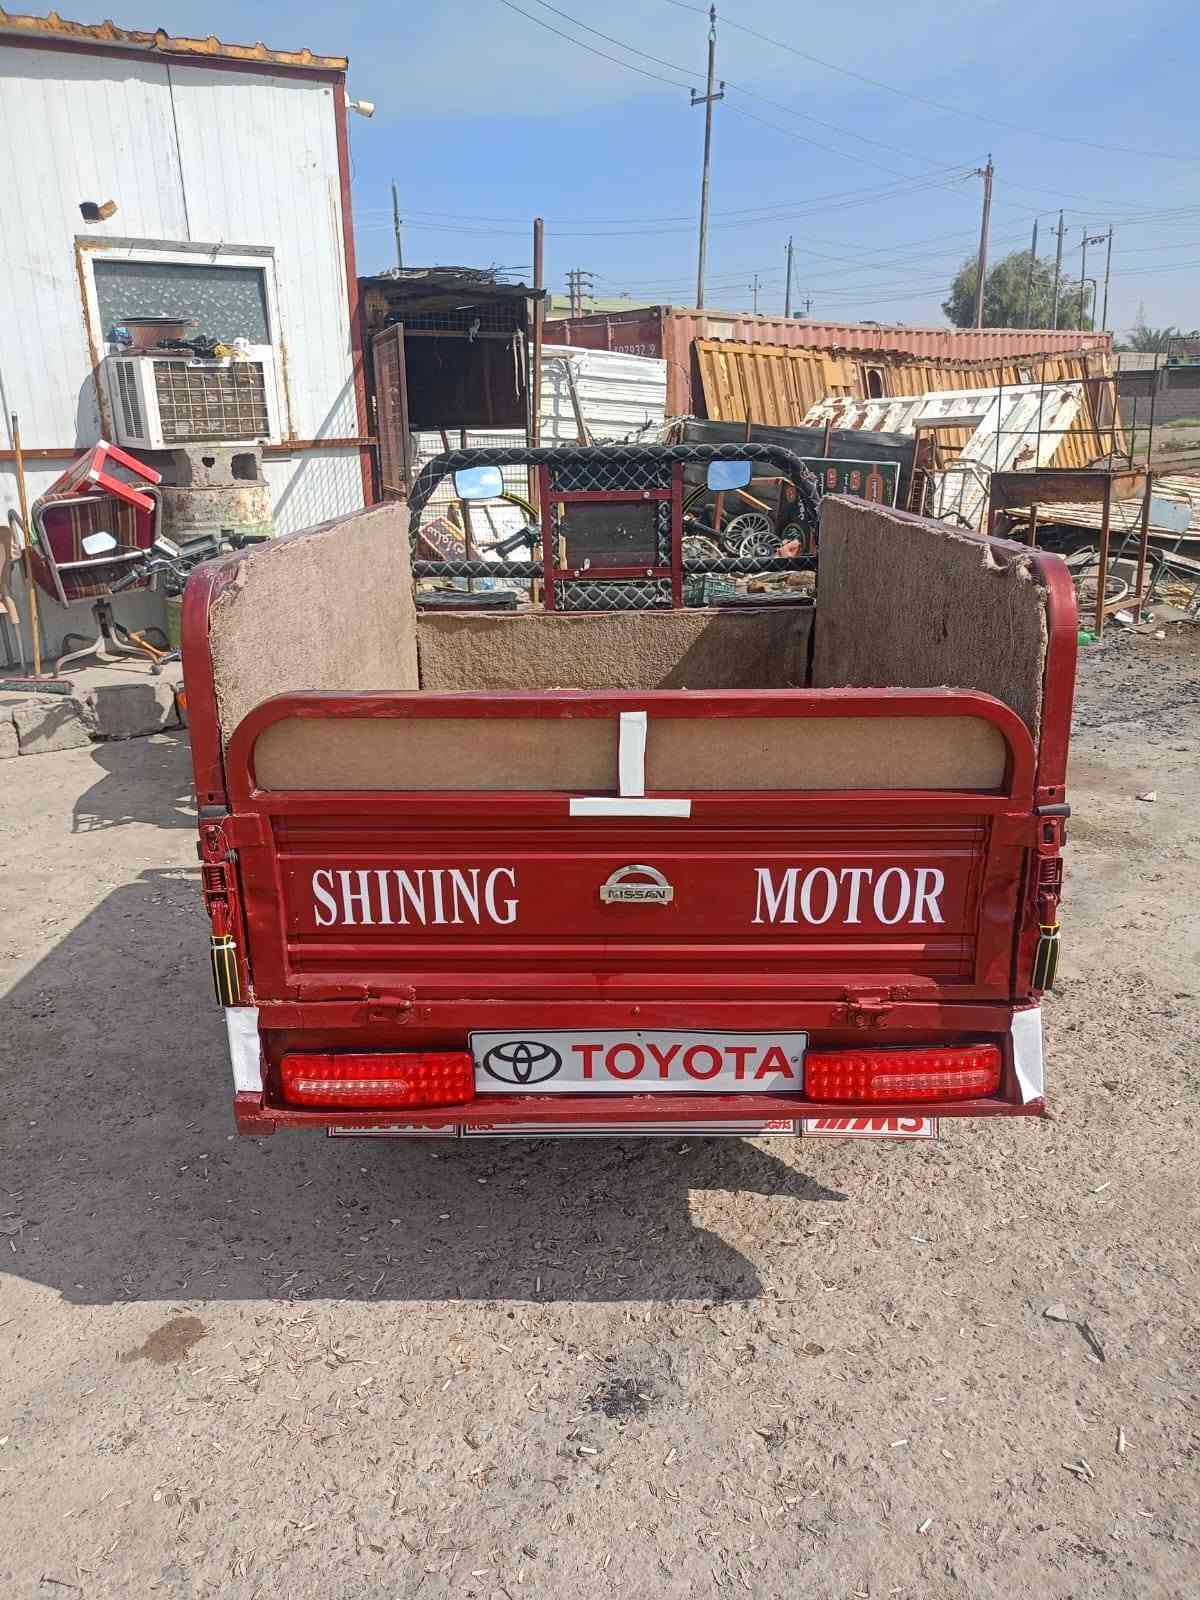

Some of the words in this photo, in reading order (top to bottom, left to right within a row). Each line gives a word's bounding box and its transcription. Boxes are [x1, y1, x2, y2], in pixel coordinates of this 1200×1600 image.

[312, 867, 519, 927] SHINING
[607, 889, 666, 899] NISSAN
[751, 866, 946, 925] MOTOR
[571, 1043, 794, 1080] TOYOTA
